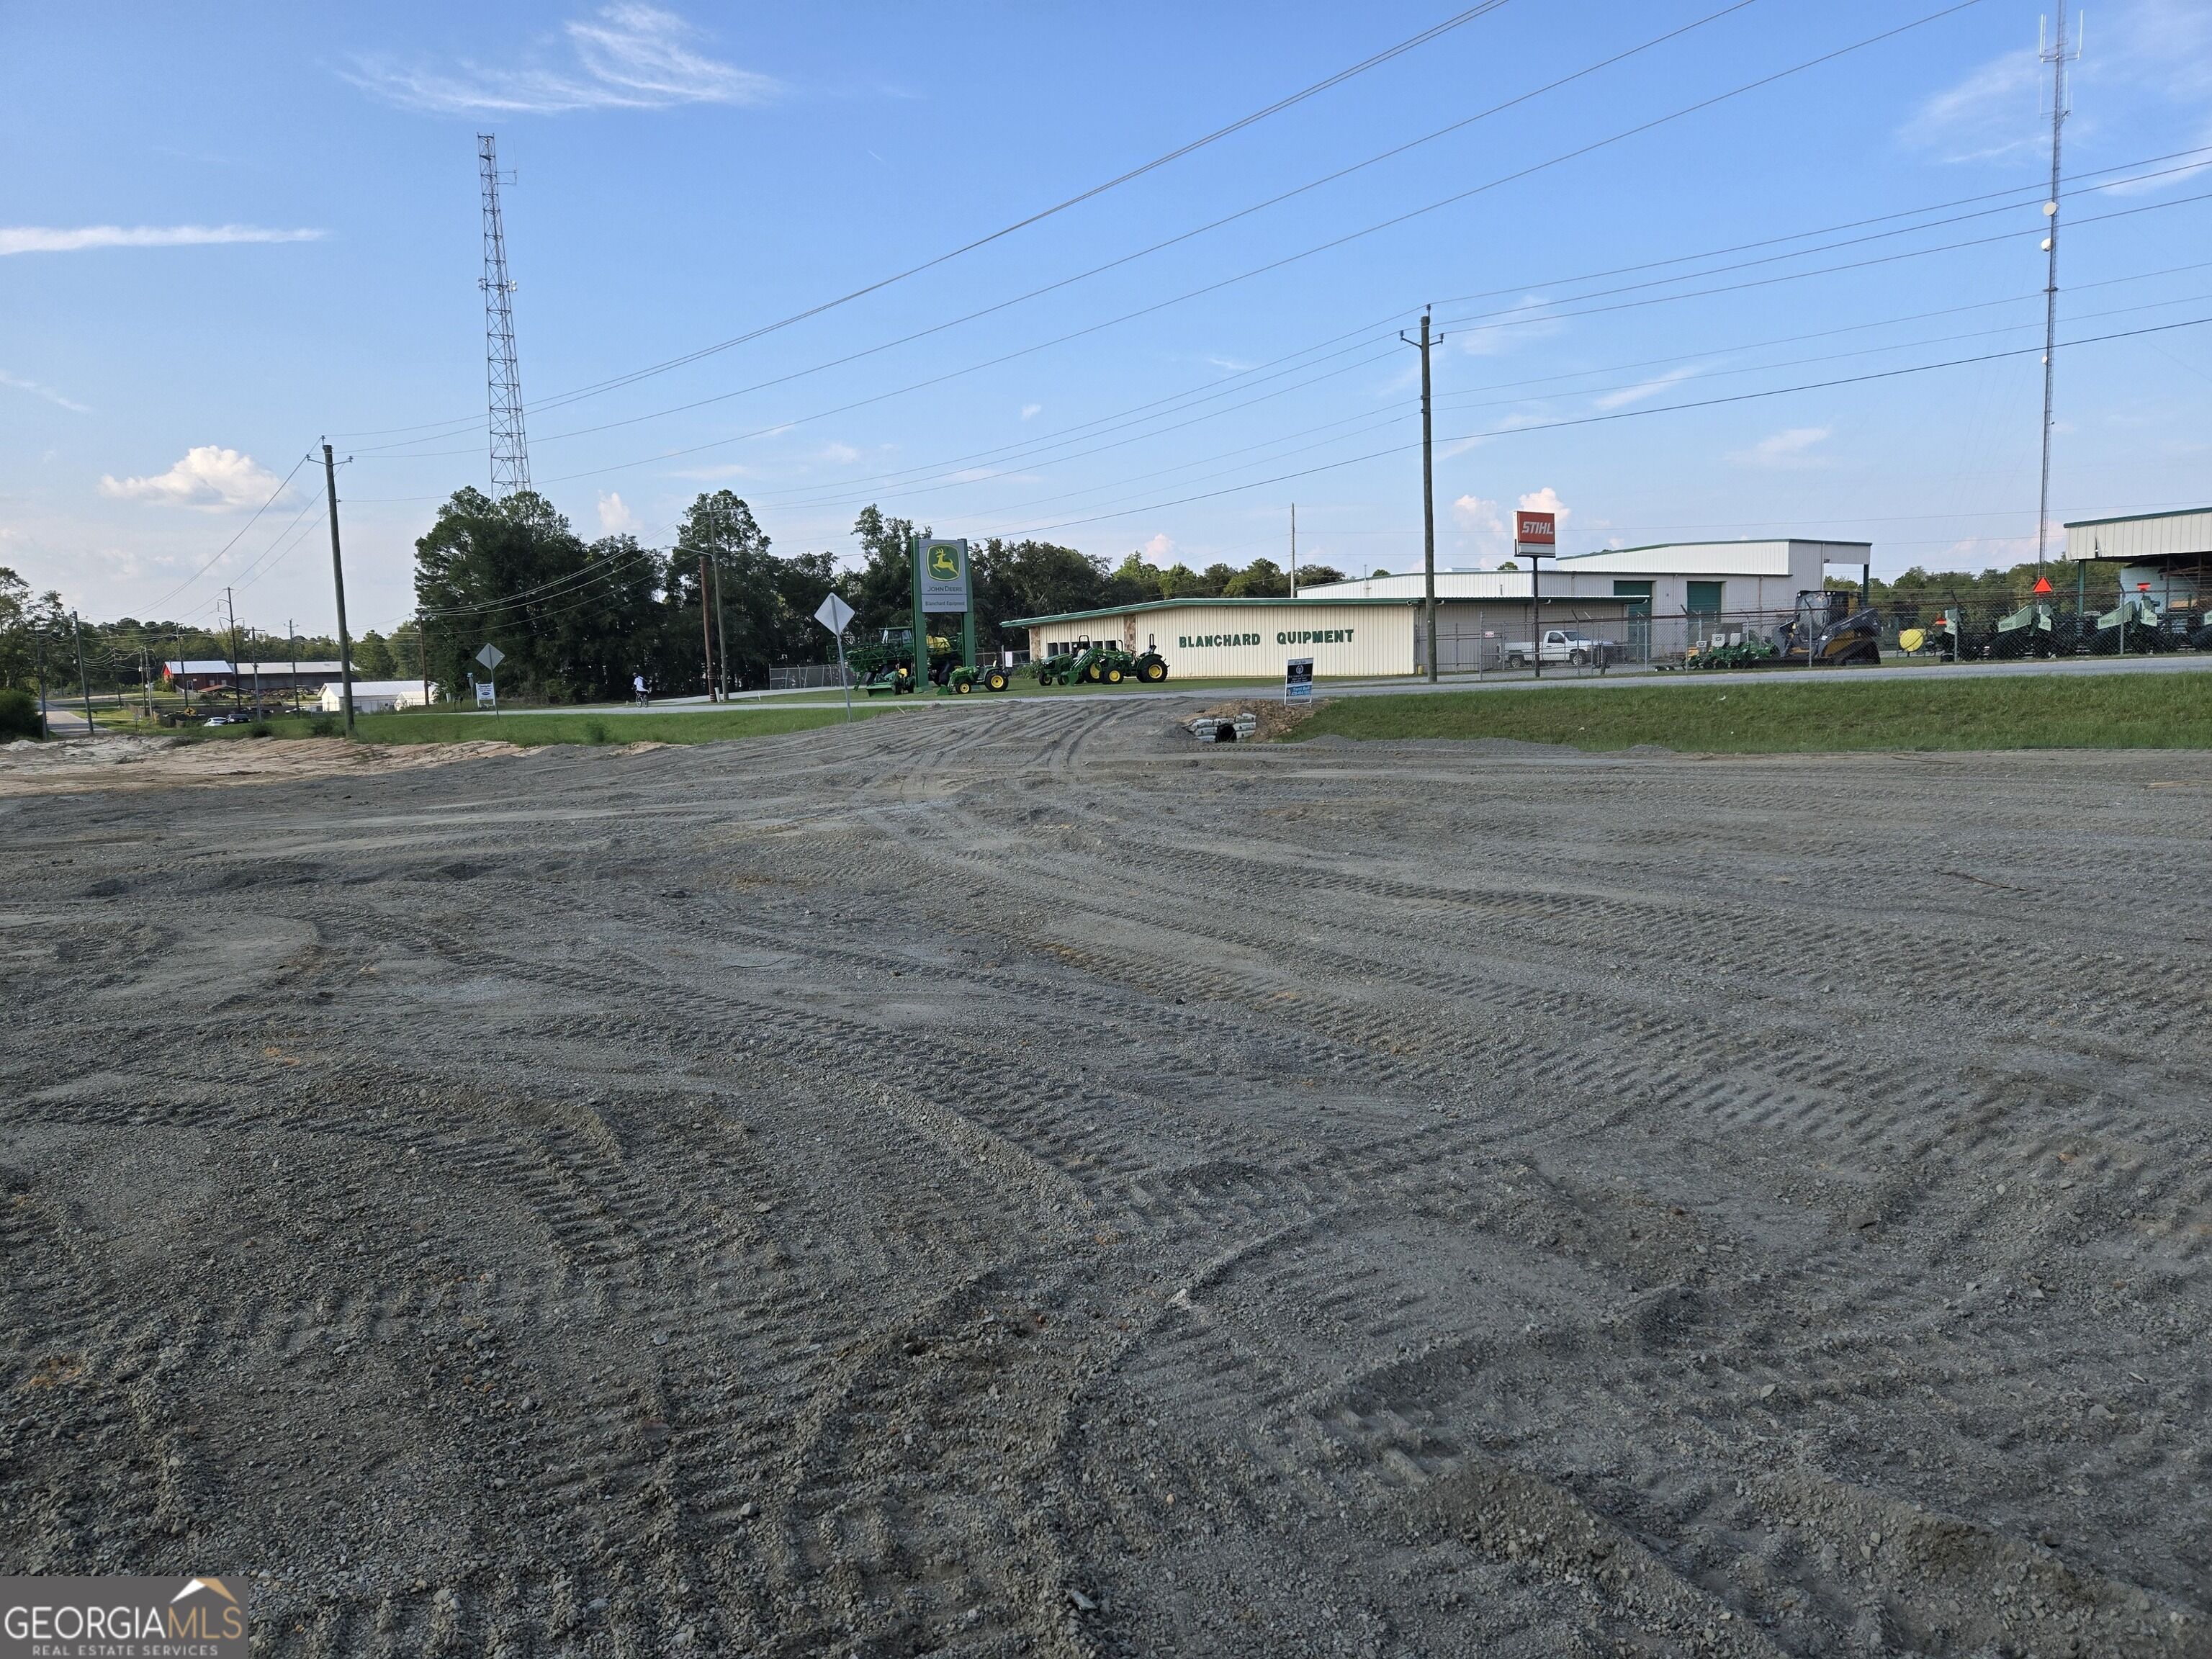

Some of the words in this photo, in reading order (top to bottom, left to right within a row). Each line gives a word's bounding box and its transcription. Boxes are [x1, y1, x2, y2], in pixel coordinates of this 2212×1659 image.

[1521, 521, 1554, 534] STIHL
[1179, 633, 1261, 649] BLANCHARD
[1276, 629, 1354, 645] QUIPMENT
